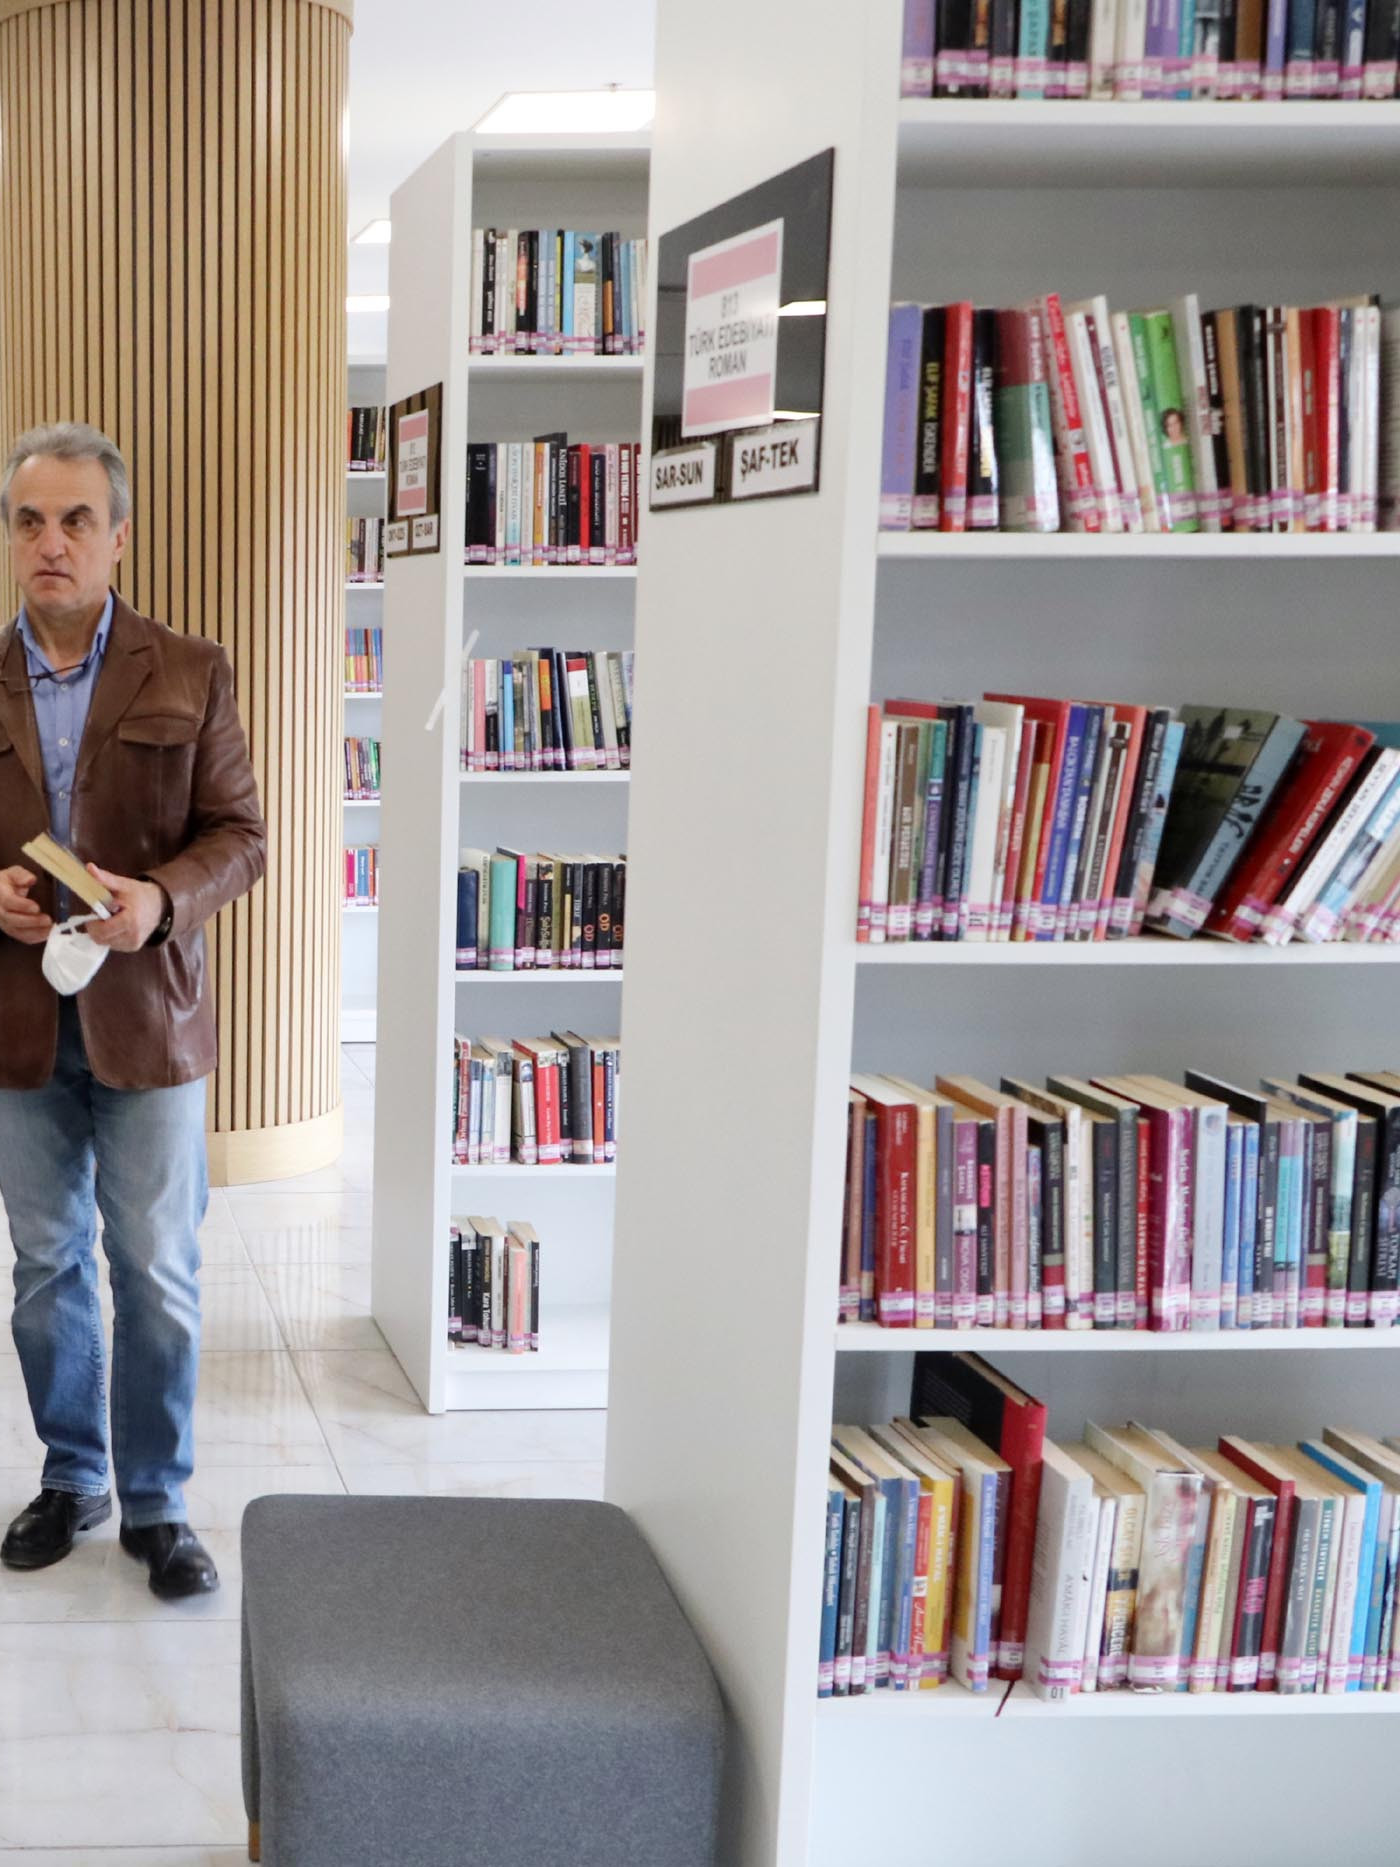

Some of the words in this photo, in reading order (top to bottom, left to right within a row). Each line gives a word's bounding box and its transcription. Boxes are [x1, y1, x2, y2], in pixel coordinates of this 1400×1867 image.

[689, 327, 715, 357] TÜRK
[709, 349, 747, 379] ROMAN
[655, 460, 704, 490] SAR-SUN
[740, 438, 800, 482] ŞAF-TEK
[959, 1237, 971, 1266] PROVA
[1387, 1233, 1399, 1280] TOPKAPI
